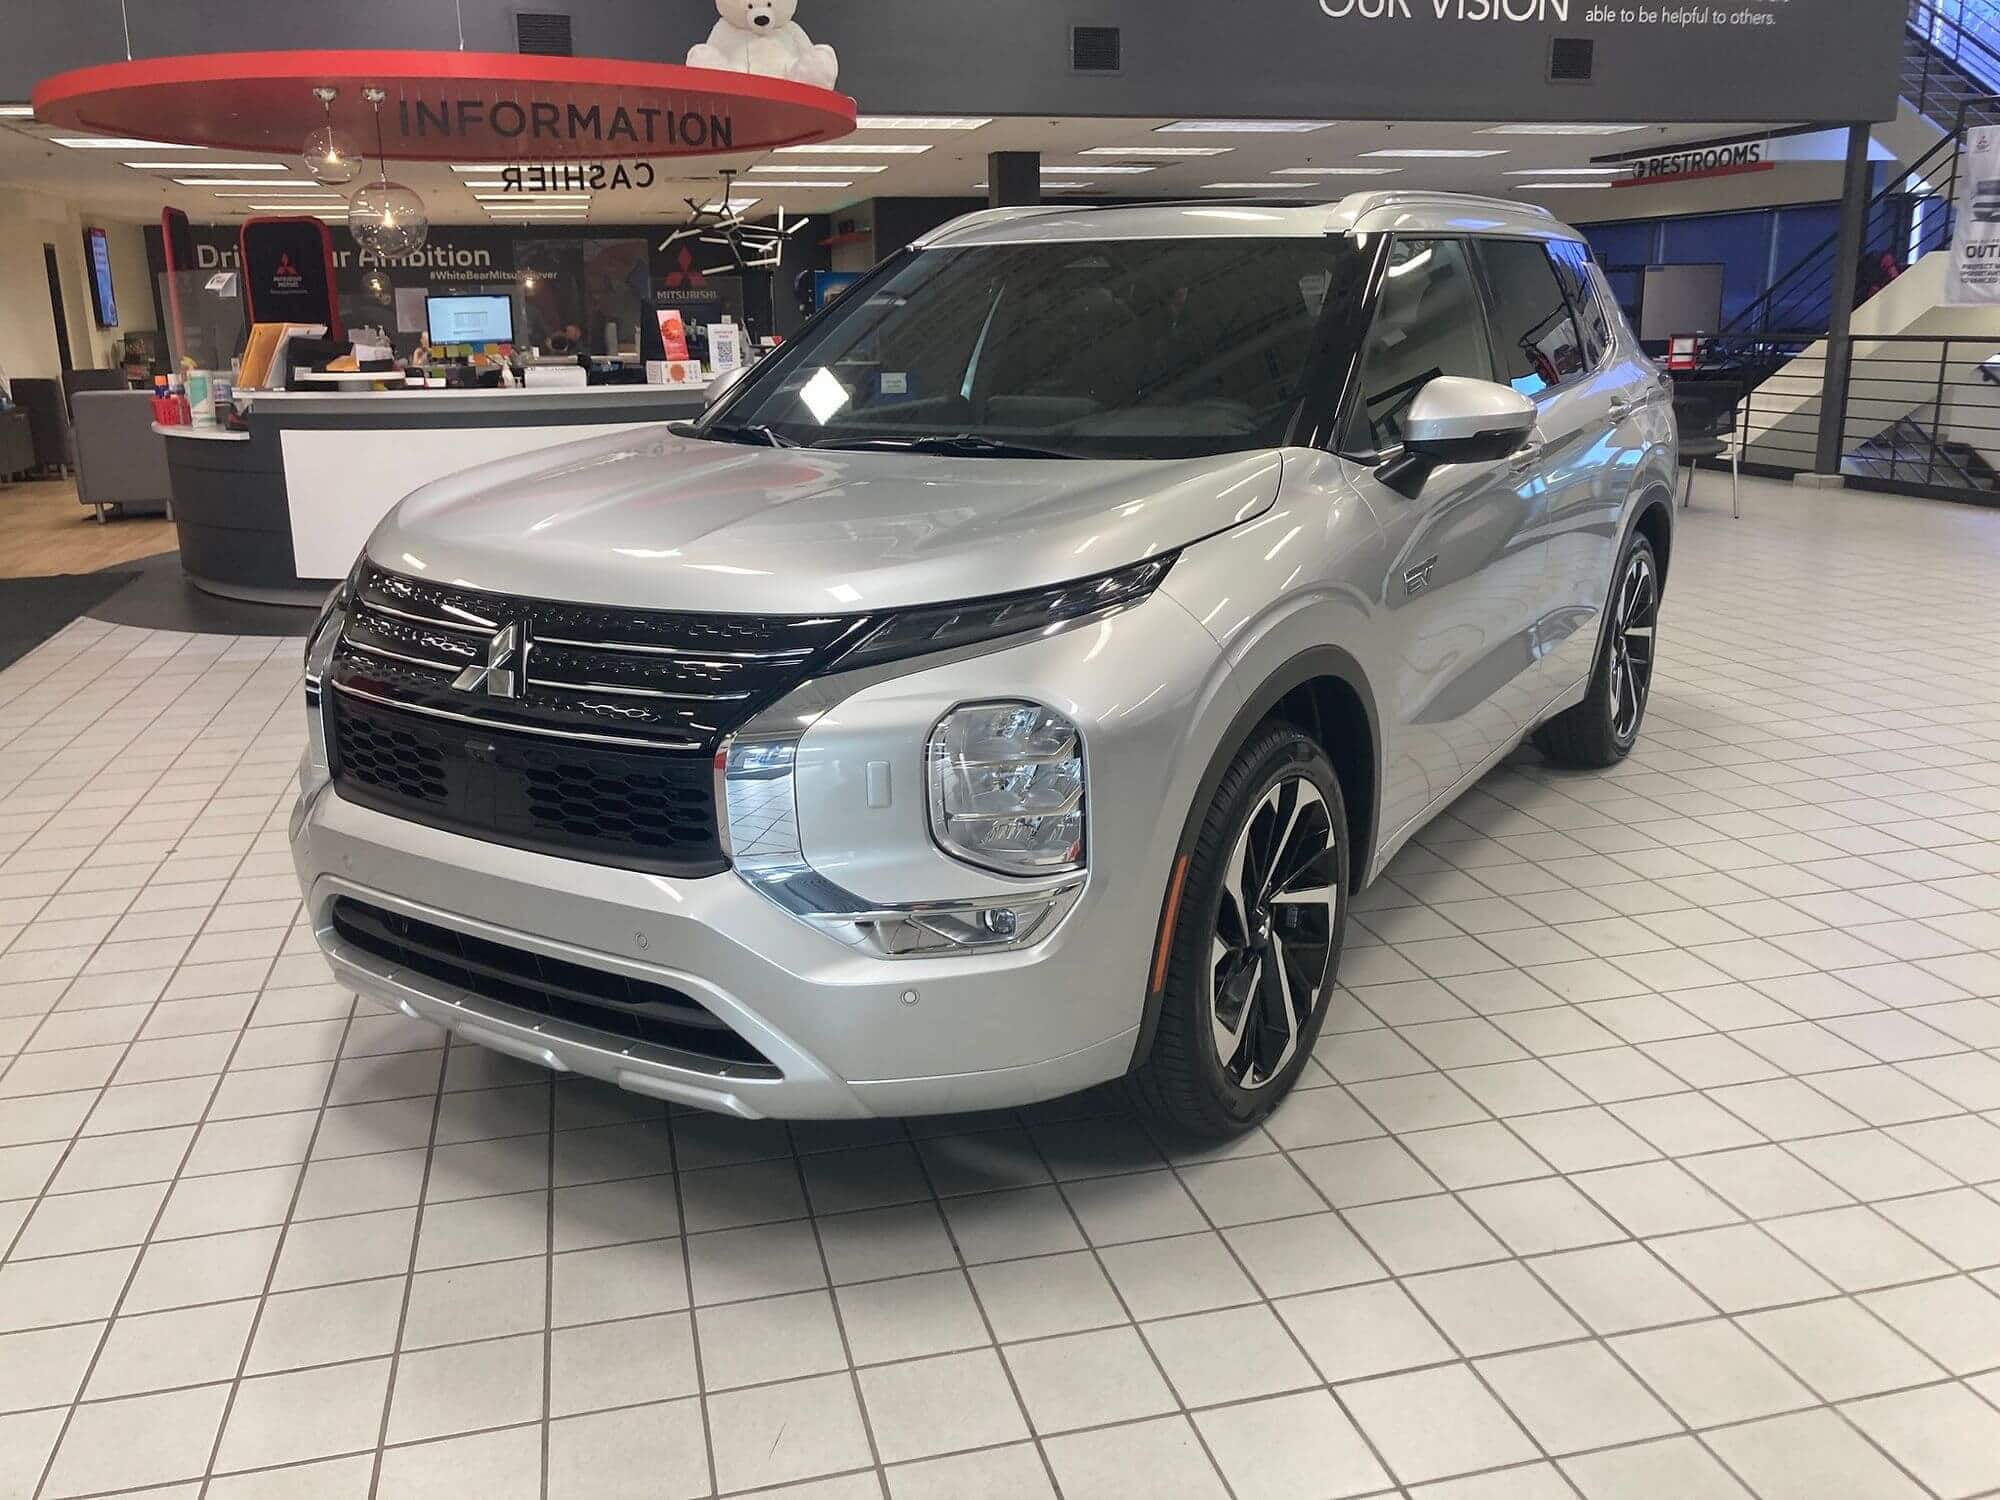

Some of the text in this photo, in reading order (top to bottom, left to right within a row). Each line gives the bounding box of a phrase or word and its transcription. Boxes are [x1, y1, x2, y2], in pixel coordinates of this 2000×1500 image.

[1432, 0, 1568, 22] VISION
[1585, 5, 1776, 28] able to be helpful to others.
[399, 99, 733, 148] INFORMATION
[1649, 143, 1761, 177] RESTROOMS
[1966, 244, 2000, 259] OUT
